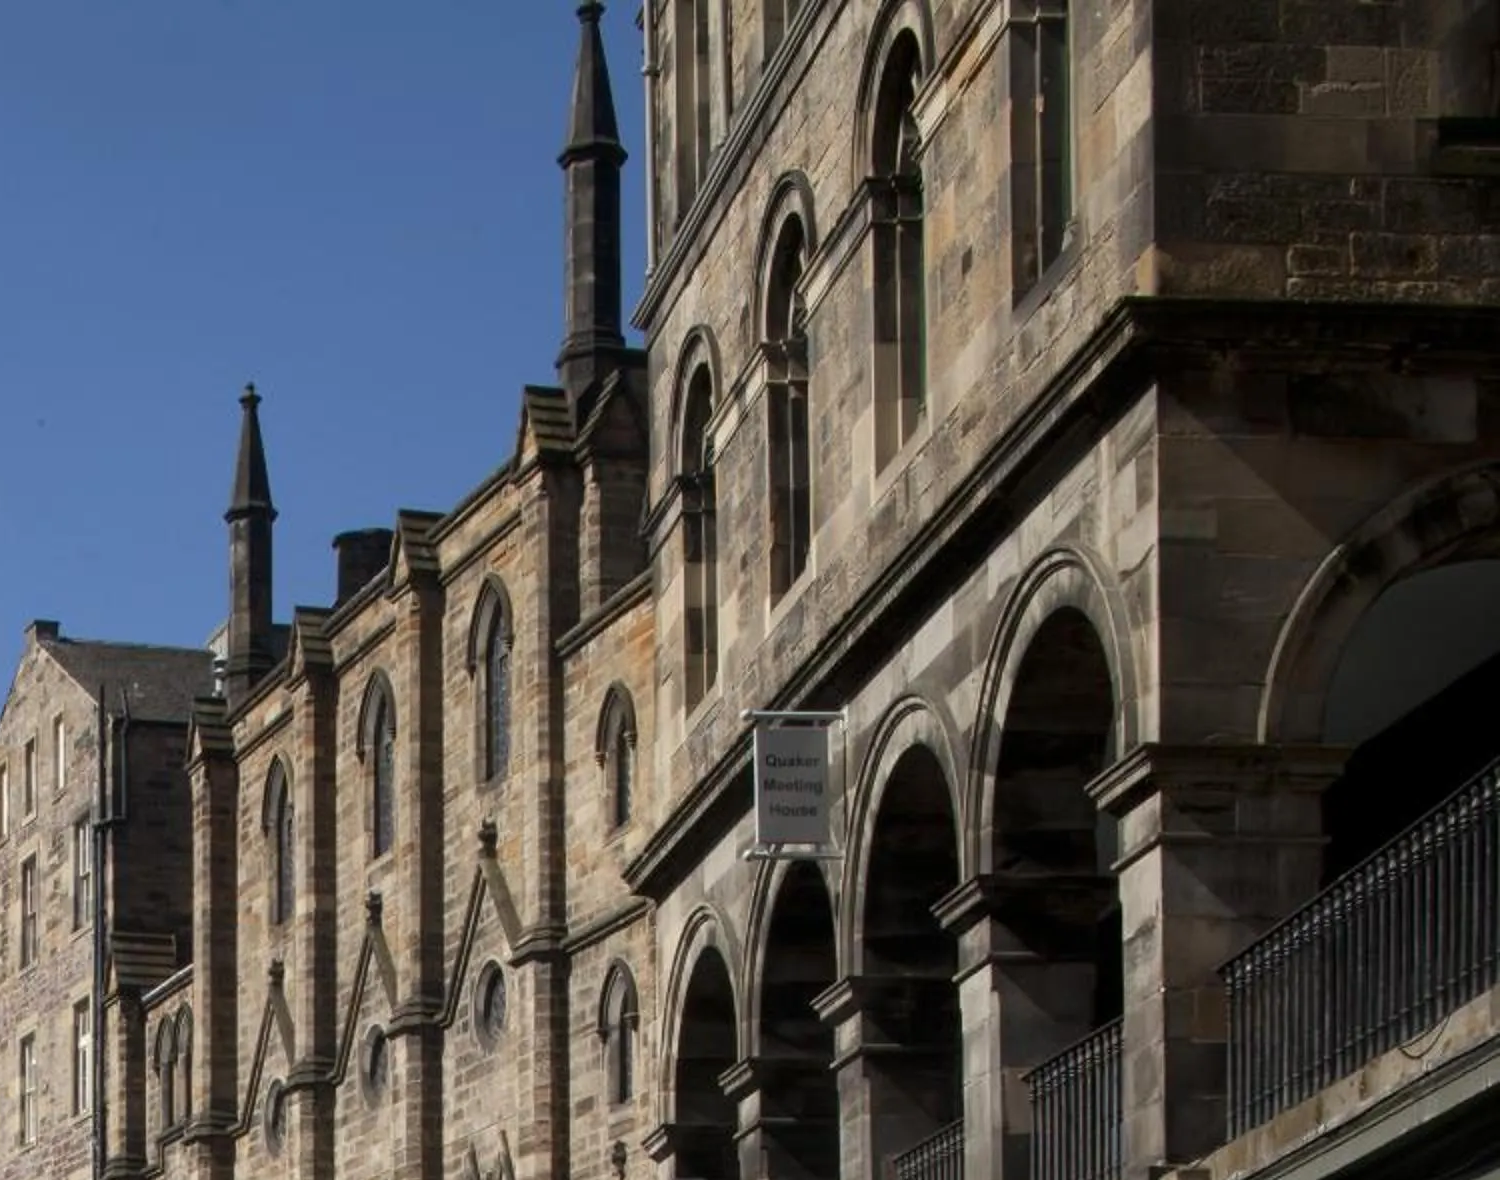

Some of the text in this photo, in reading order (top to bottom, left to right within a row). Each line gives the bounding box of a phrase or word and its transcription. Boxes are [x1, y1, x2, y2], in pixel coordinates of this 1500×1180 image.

[766, 754, 820, 768] Quaker
[764, 778, 823, 796] Meeting
[770, 803, 817, 817] House
